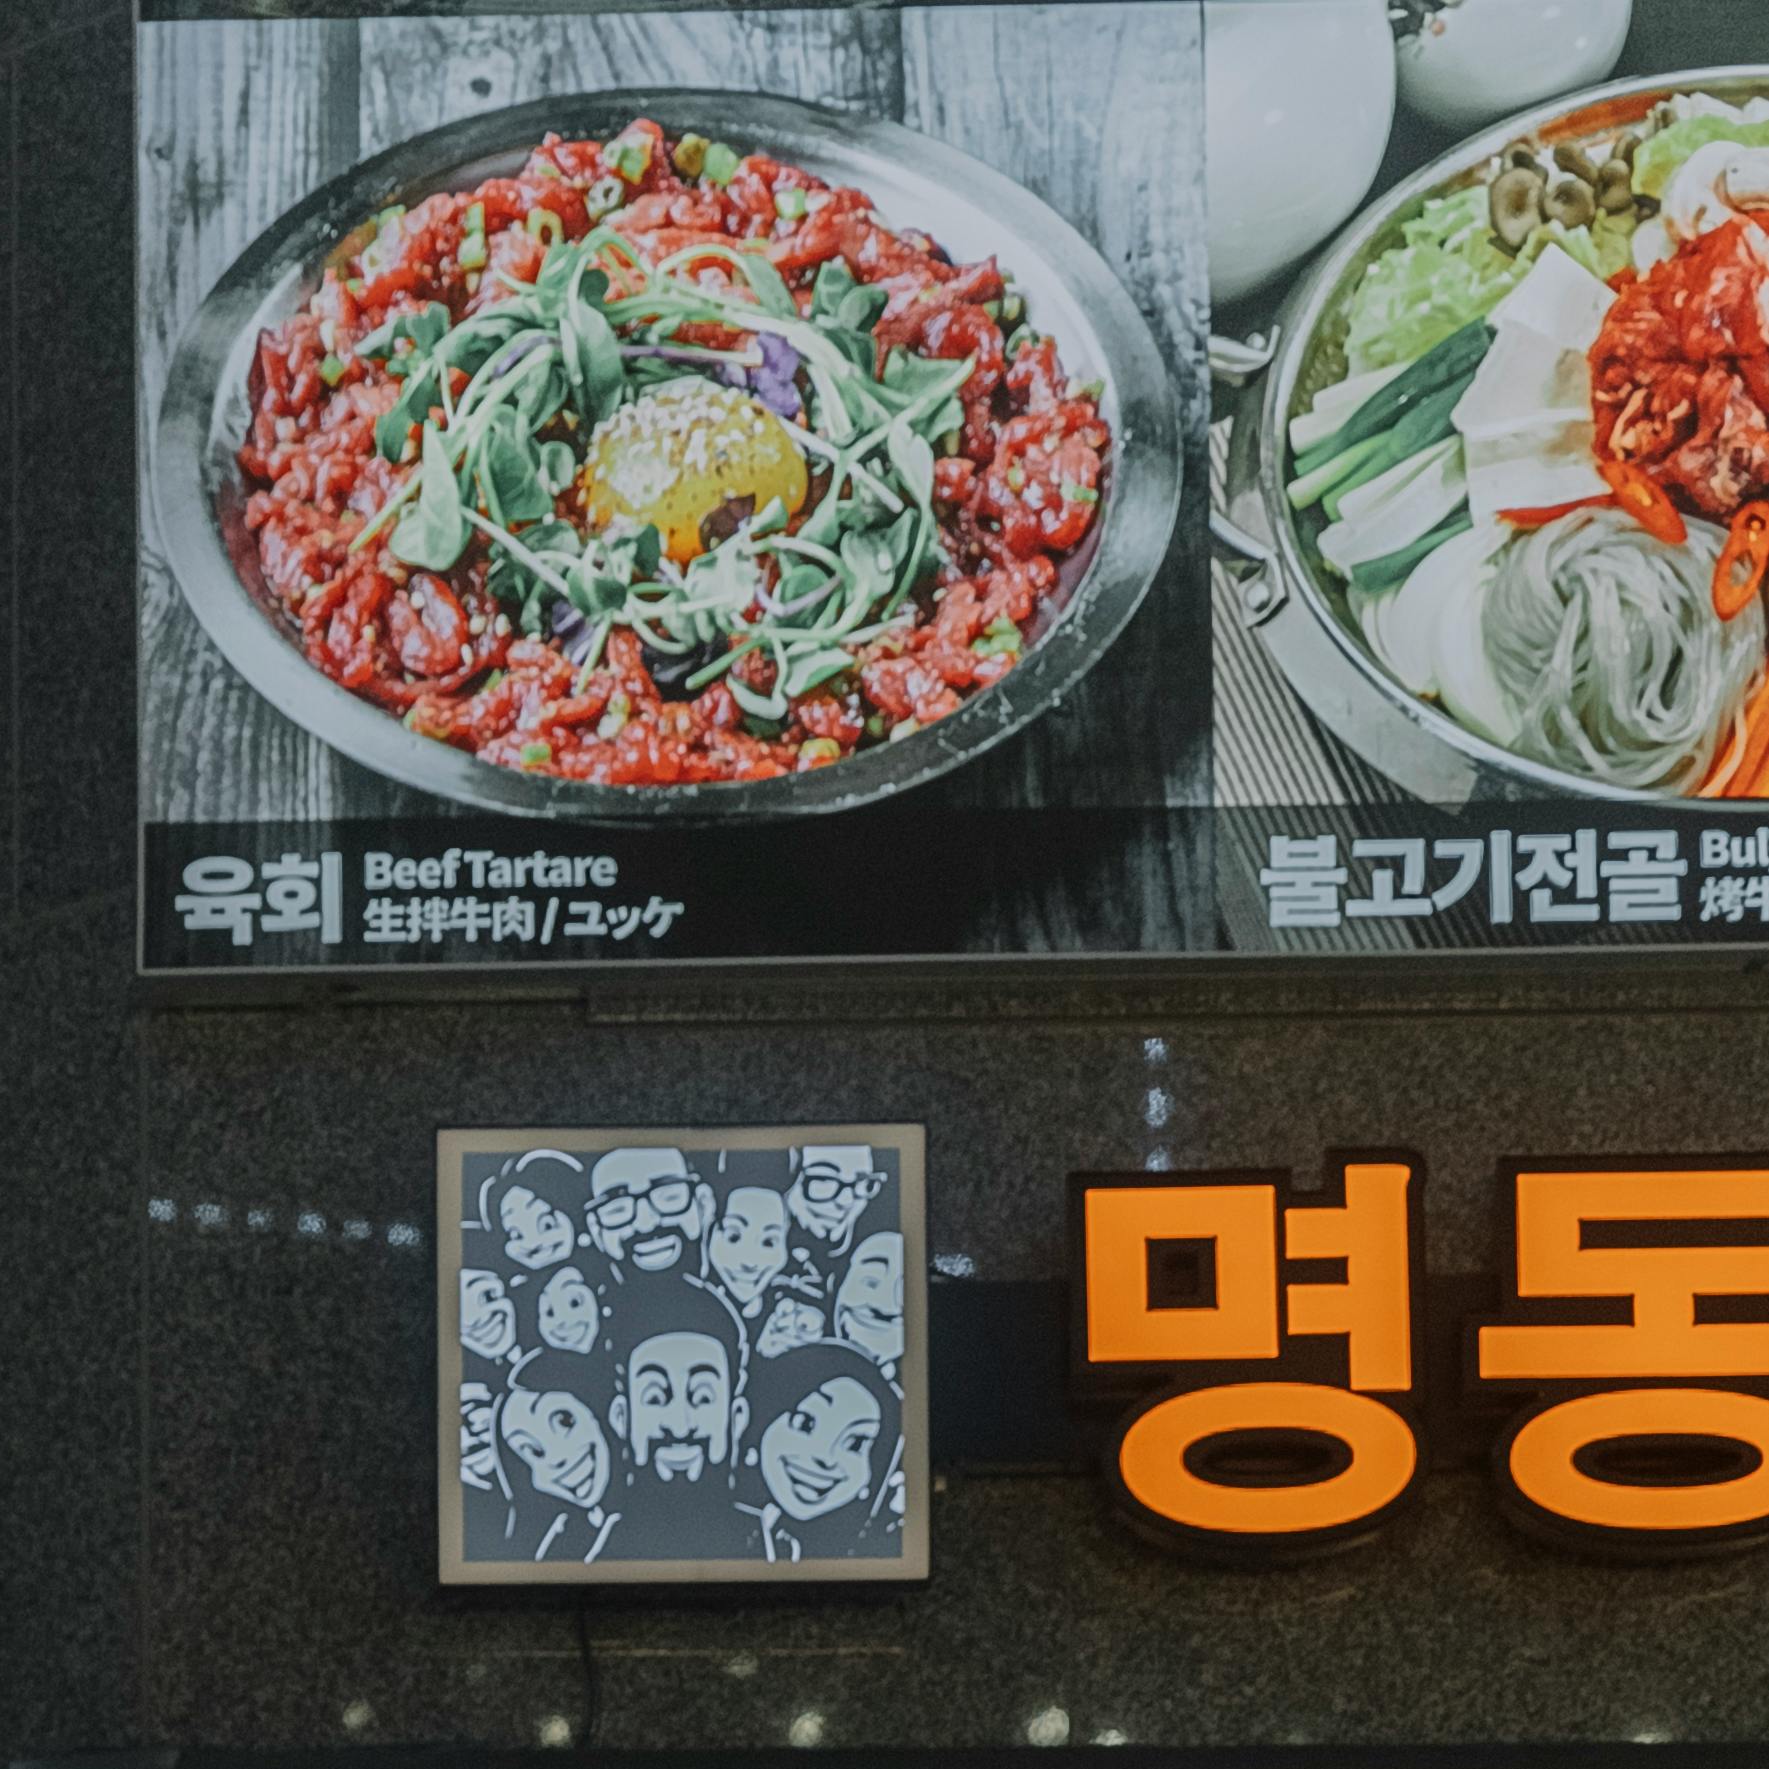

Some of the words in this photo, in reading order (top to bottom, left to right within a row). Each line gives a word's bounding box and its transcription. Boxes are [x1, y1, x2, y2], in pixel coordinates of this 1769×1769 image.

[175, 851, 343, 947] 육회
[363, 847, 460, 891] Beef
[463, 850, 619, 889] Tartare
[1260, 827, 1689, 929] 불고기전골
[1084, 1162, 1769, 1533] 명동
